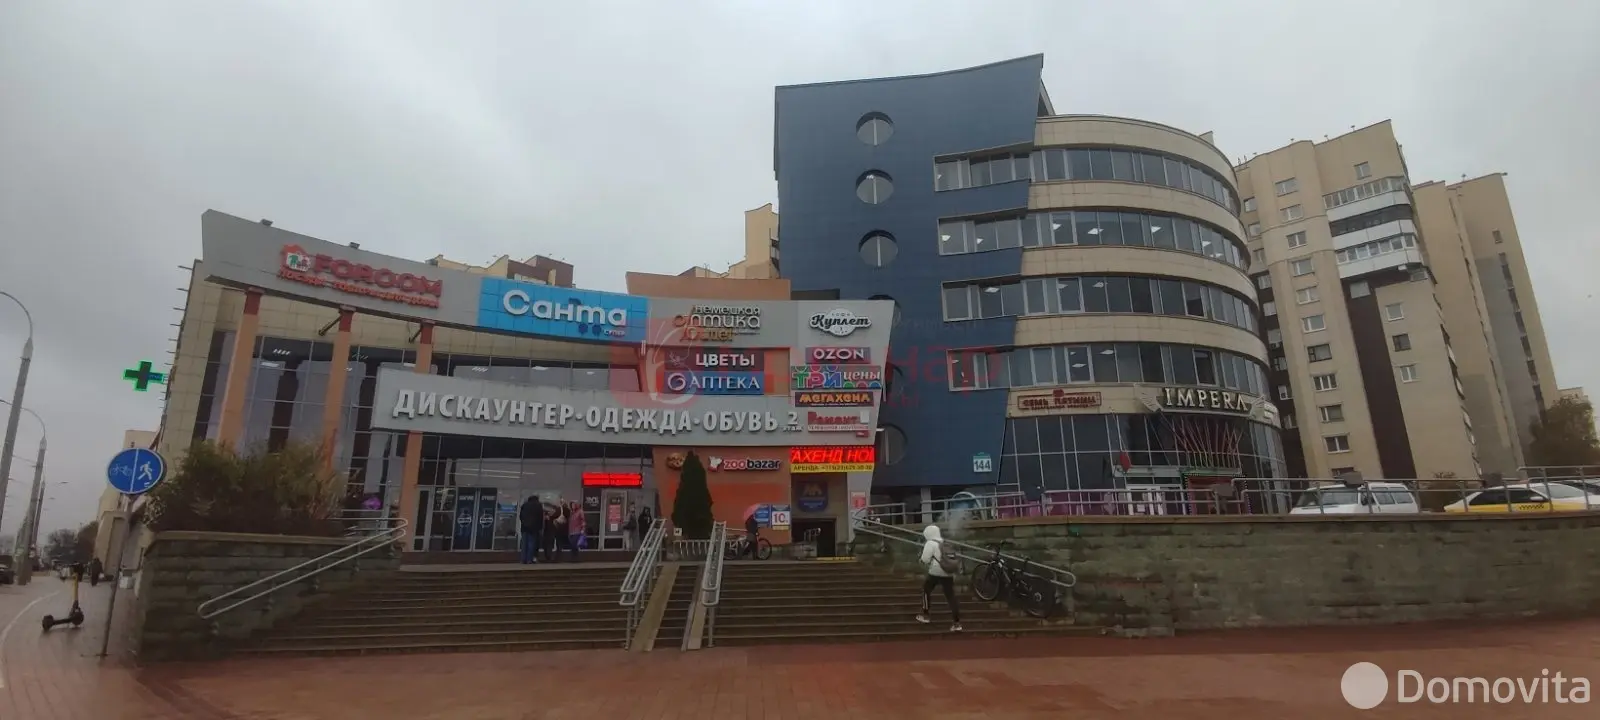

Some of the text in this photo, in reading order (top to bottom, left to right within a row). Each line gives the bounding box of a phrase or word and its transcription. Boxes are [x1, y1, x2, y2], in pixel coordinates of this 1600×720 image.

[503, 289, 628, 327] Санта
[811, 314, 869, 329] Куплет
[695, 353, 755, 367] ЦВЕТЫ
[813, 348, 864, 360] OZON
[688, 376, 761, 389] АПТЕКА
[843, 371, 880, 381] цены
[392, 389, 799, 435] ДИСКАУНТЕР ОДЕЖДА ОБУВЬ 2
[723, 458, 780, 470] zoobazar
[974, 459, 991, 470] 144
